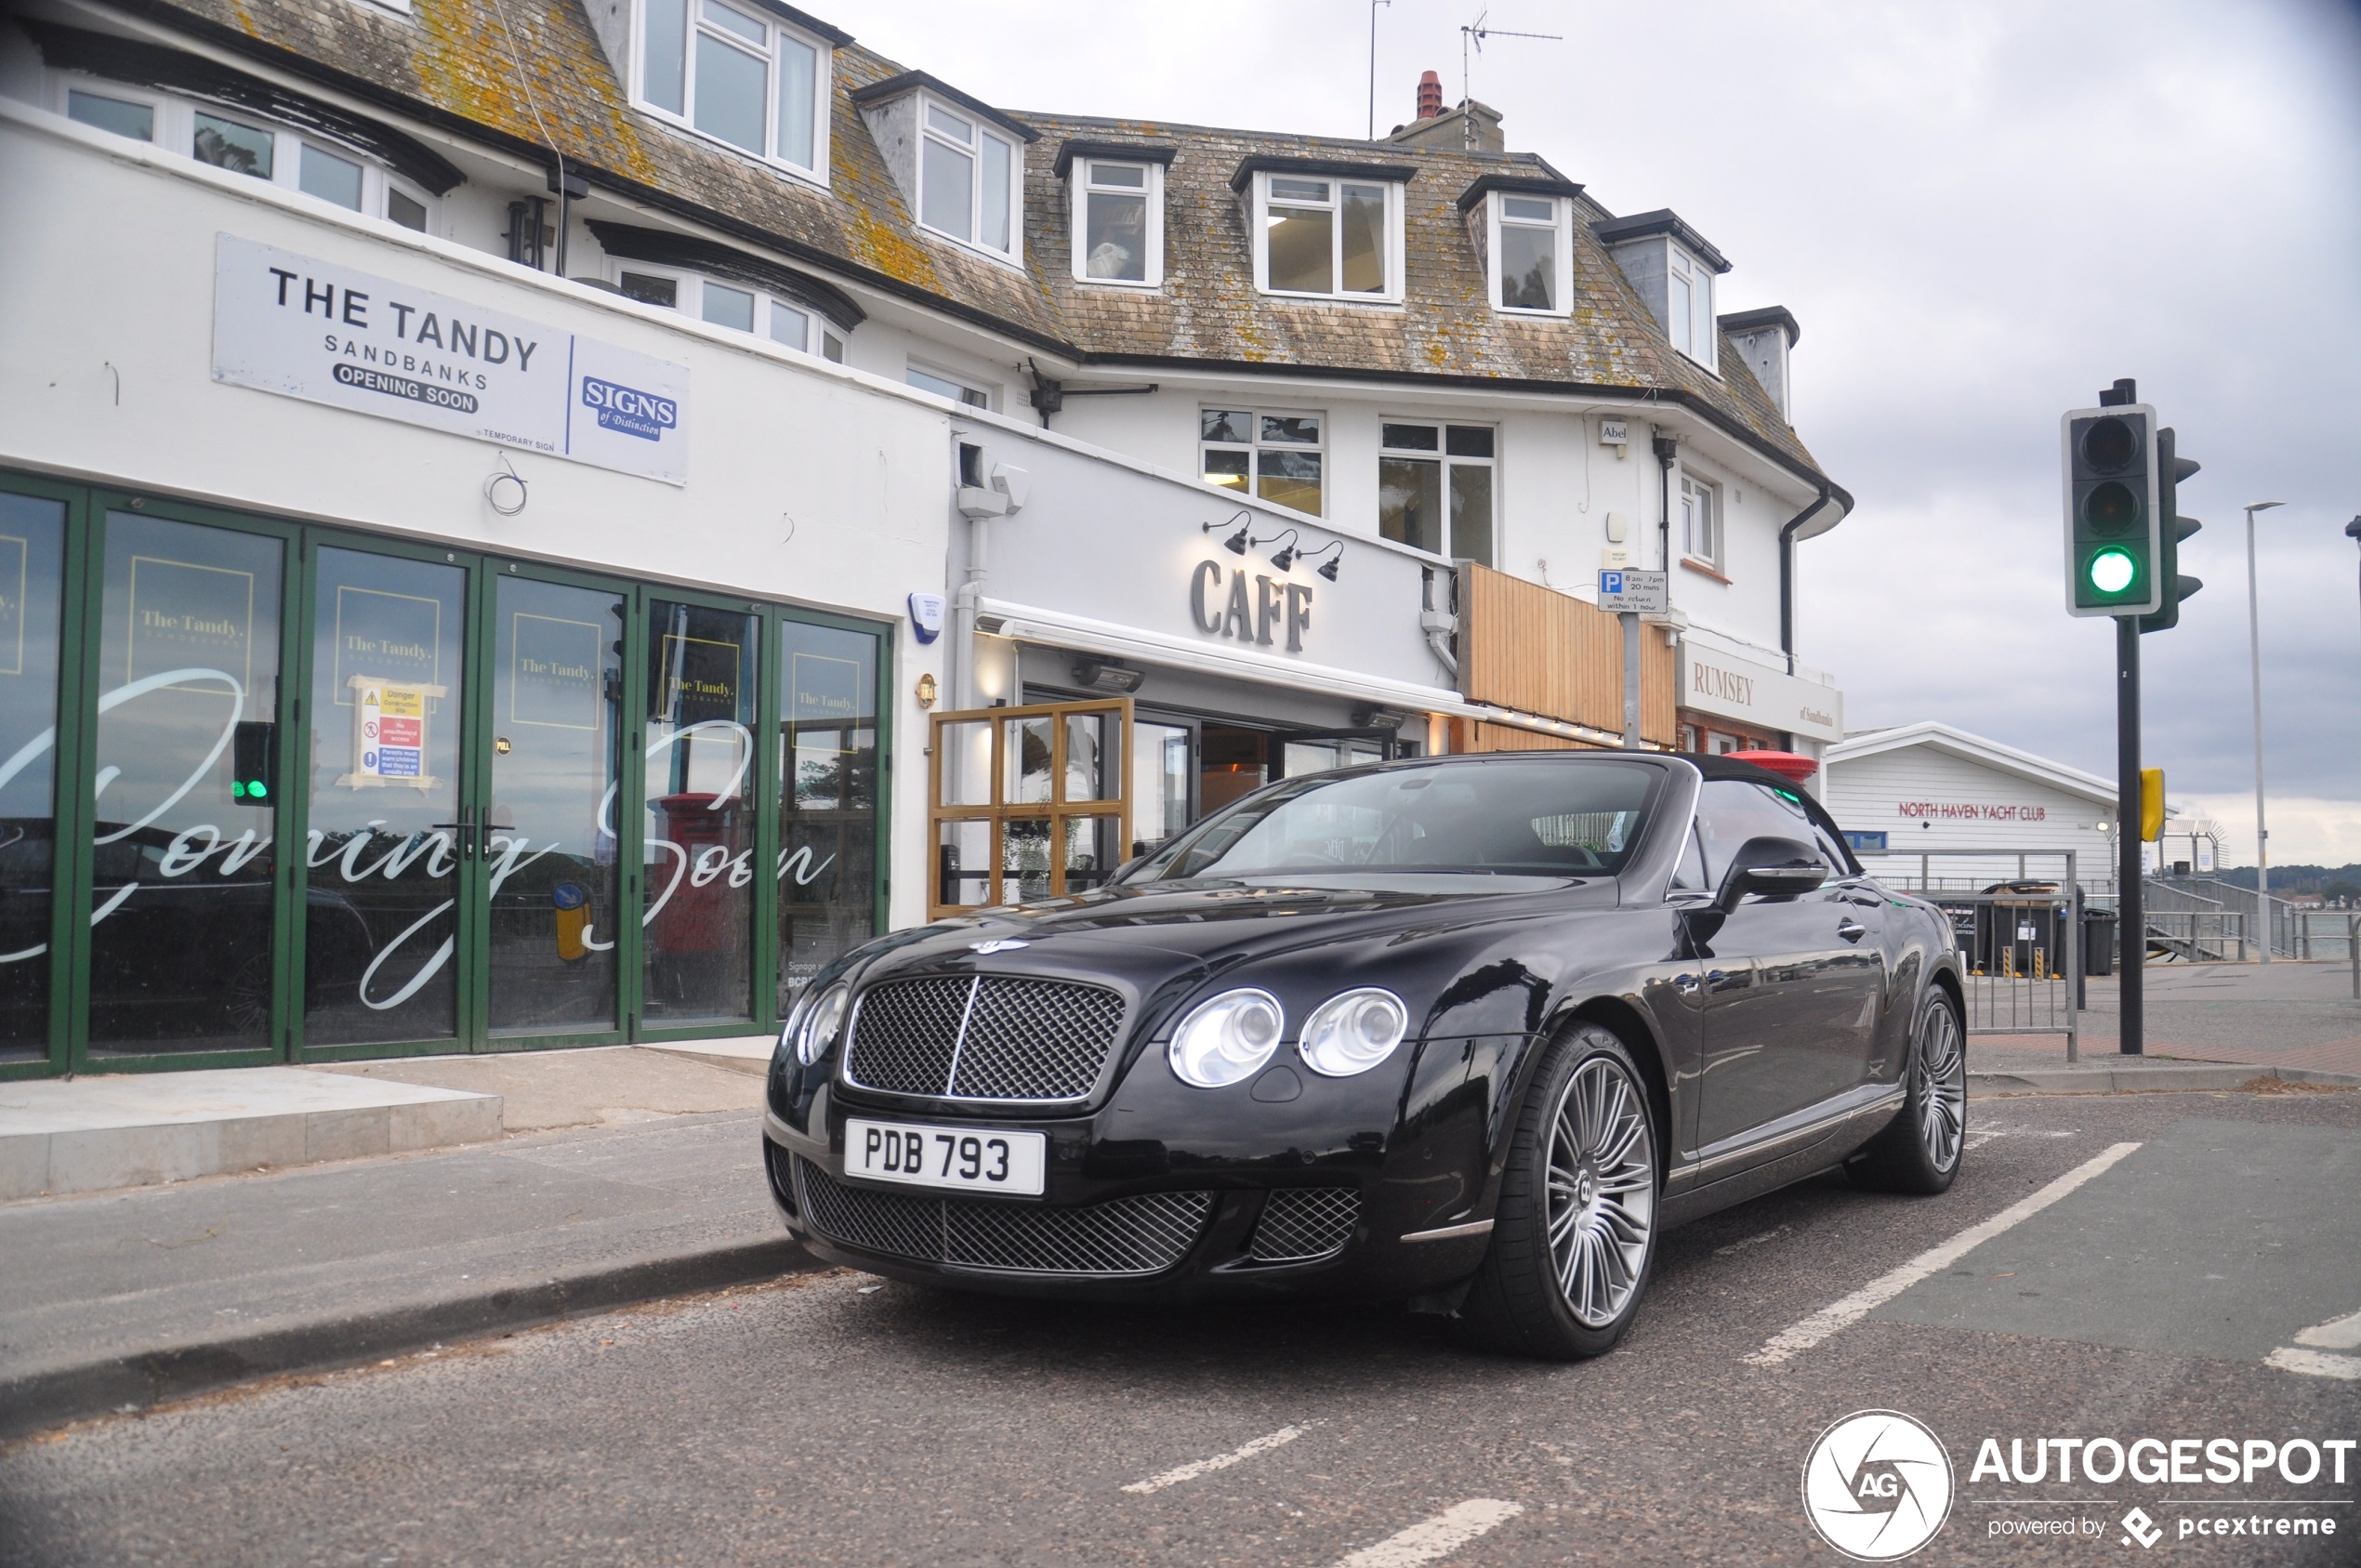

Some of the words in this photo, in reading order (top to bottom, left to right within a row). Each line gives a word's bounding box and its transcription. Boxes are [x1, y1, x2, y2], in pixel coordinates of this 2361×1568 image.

[270, 267, 369, 328] THE
[389, 301, 537, 372] TANDY
[325, 335, 487, 389] SANDBANKS
[339, 366, 418, 398] OPENING
[426, 389, 474, 411] SOON
[586, 381, 674, 424] SIGNS
[600, 410, 612, 425] of
[613, 415, 659, 436] Distinction
[1603, 427, 1627, 439] Abel
[484, 428, 533, 447] TEMPORARY
[535, 441, 554, 453] SIGN
[1606, 573, 1619, 592] P
[1191, 560, 1313, 652] CAFF
[141, 610, 178, 627] The
[181, 615, 243, 639] Tandy.
[346, 635, 376, 651] The
[379, 639, 431, 661] Tandy.
[521, 658, 547, 673] The
[550, 662, 594, 680] Tandy.
[387, 691, 415, 700] Danger
[669, 677, 692, 691] The
[694, 680, 733, 698] Tandy.
[1694, 662, 1754, 706] RUMSEY
[384, 700, 417, 708] Construction
[798, 692, 818, 705] The
[821, 695, 855, 711] Tandy.
[1800, 706, 1806, 720] of
[496, 741, 510, 751] PULL
[1899, 802, 1938, 818] NORTH
[1942, 804, 1978, 819] HAVEN
[1982, 805, 2016, 820] YACHT
[2020, 807, 2045, 821] CLUB
[788, 961, 817, 973] Signage
[865, 1127, 923, 1174] PDB
[935, 1134, 1009, 1182] 793
